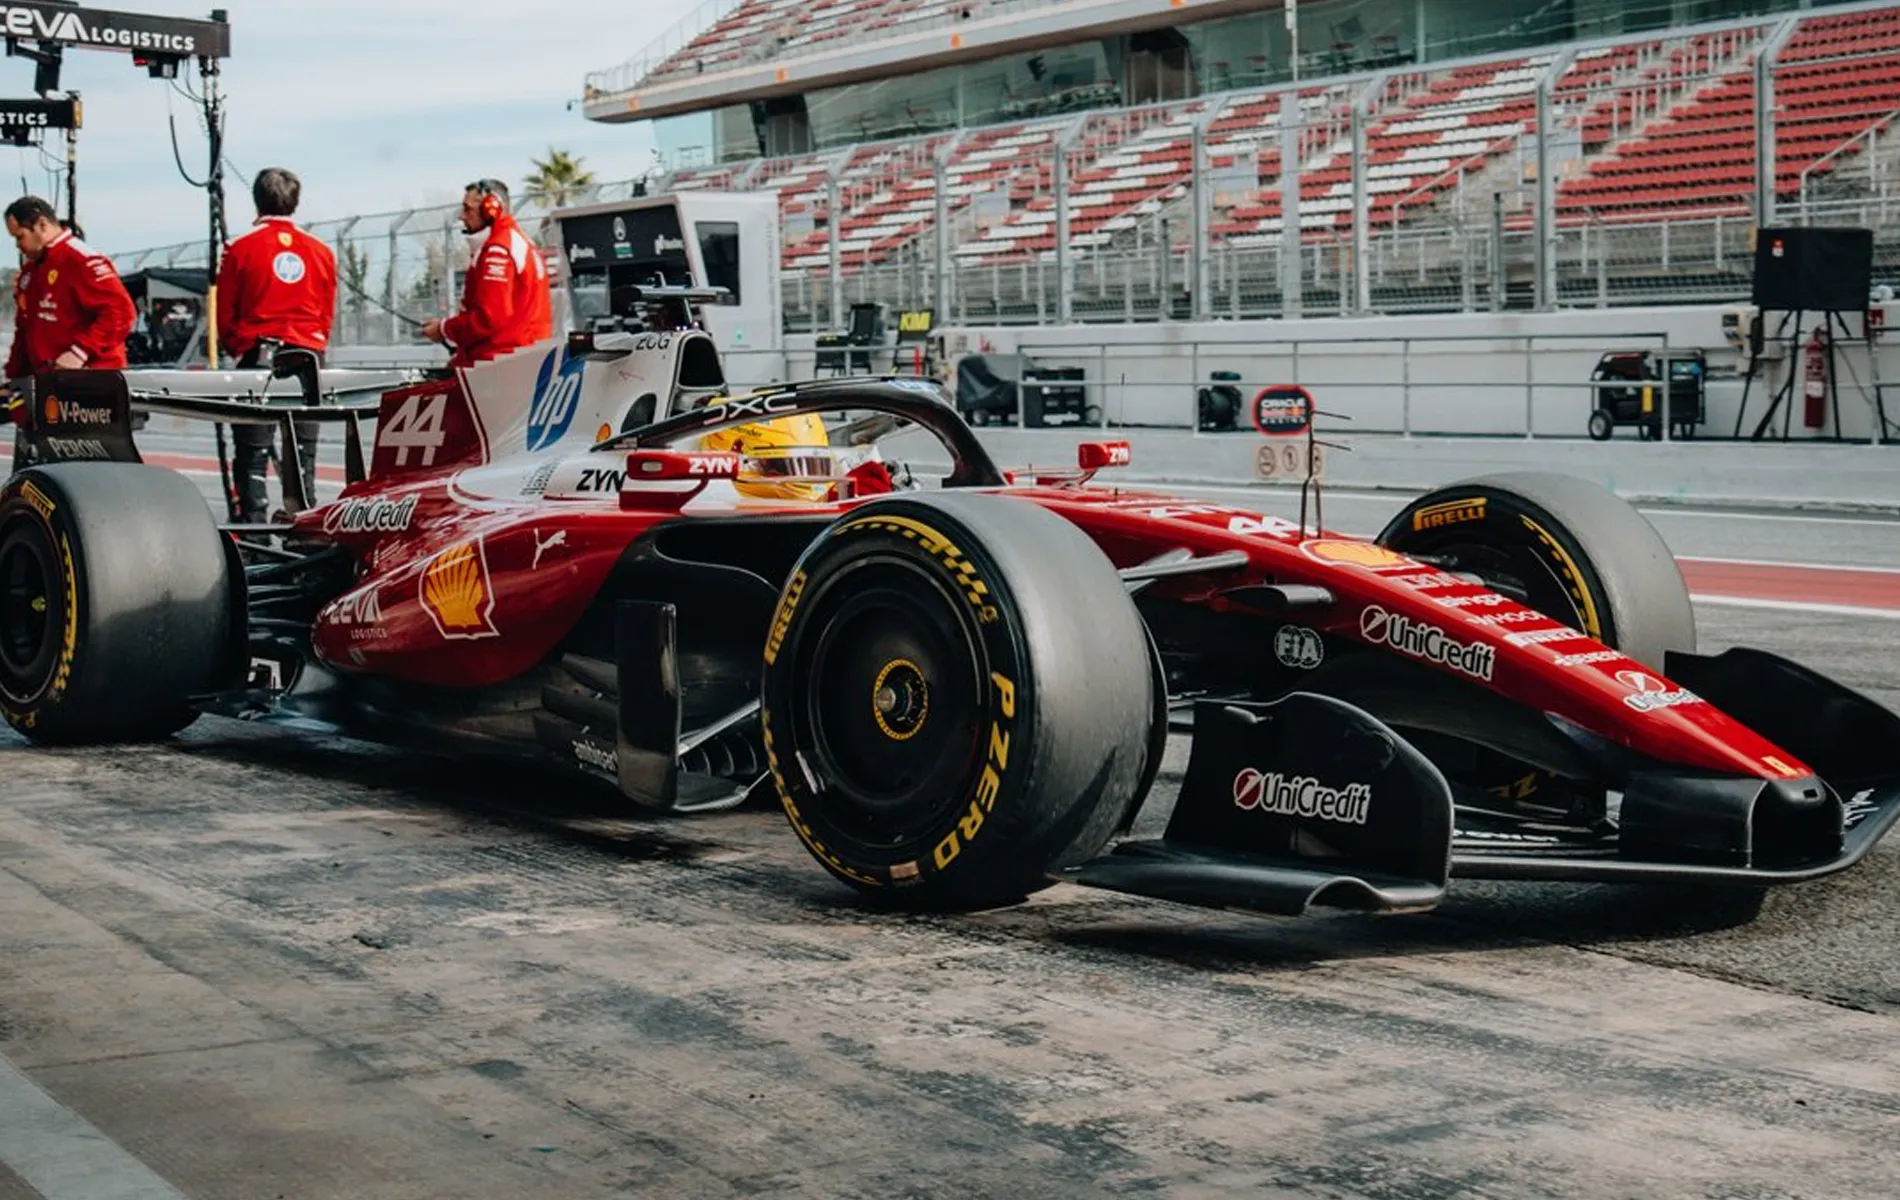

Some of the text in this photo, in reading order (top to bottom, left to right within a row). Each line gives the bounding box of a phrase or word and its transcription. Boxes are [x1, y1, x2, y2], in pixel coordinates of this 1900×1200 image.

[91, 28, 195, 50] LOGISTICS
[59, 401, 112, 424] V-Power
[527, 344, 582, 452] hp
[378, 394, 448, 466] 44
[576, 470, 627, 492] ZYN
[689, 457, 732, 474] ZYN
[341, 493, 420, 532] UniCredit
[1413, 497, 1488, 531] PIRELLI
[1388, 614, 1495, 681] UniCredit
[1261, 772, 1371, 824] UniCredit
